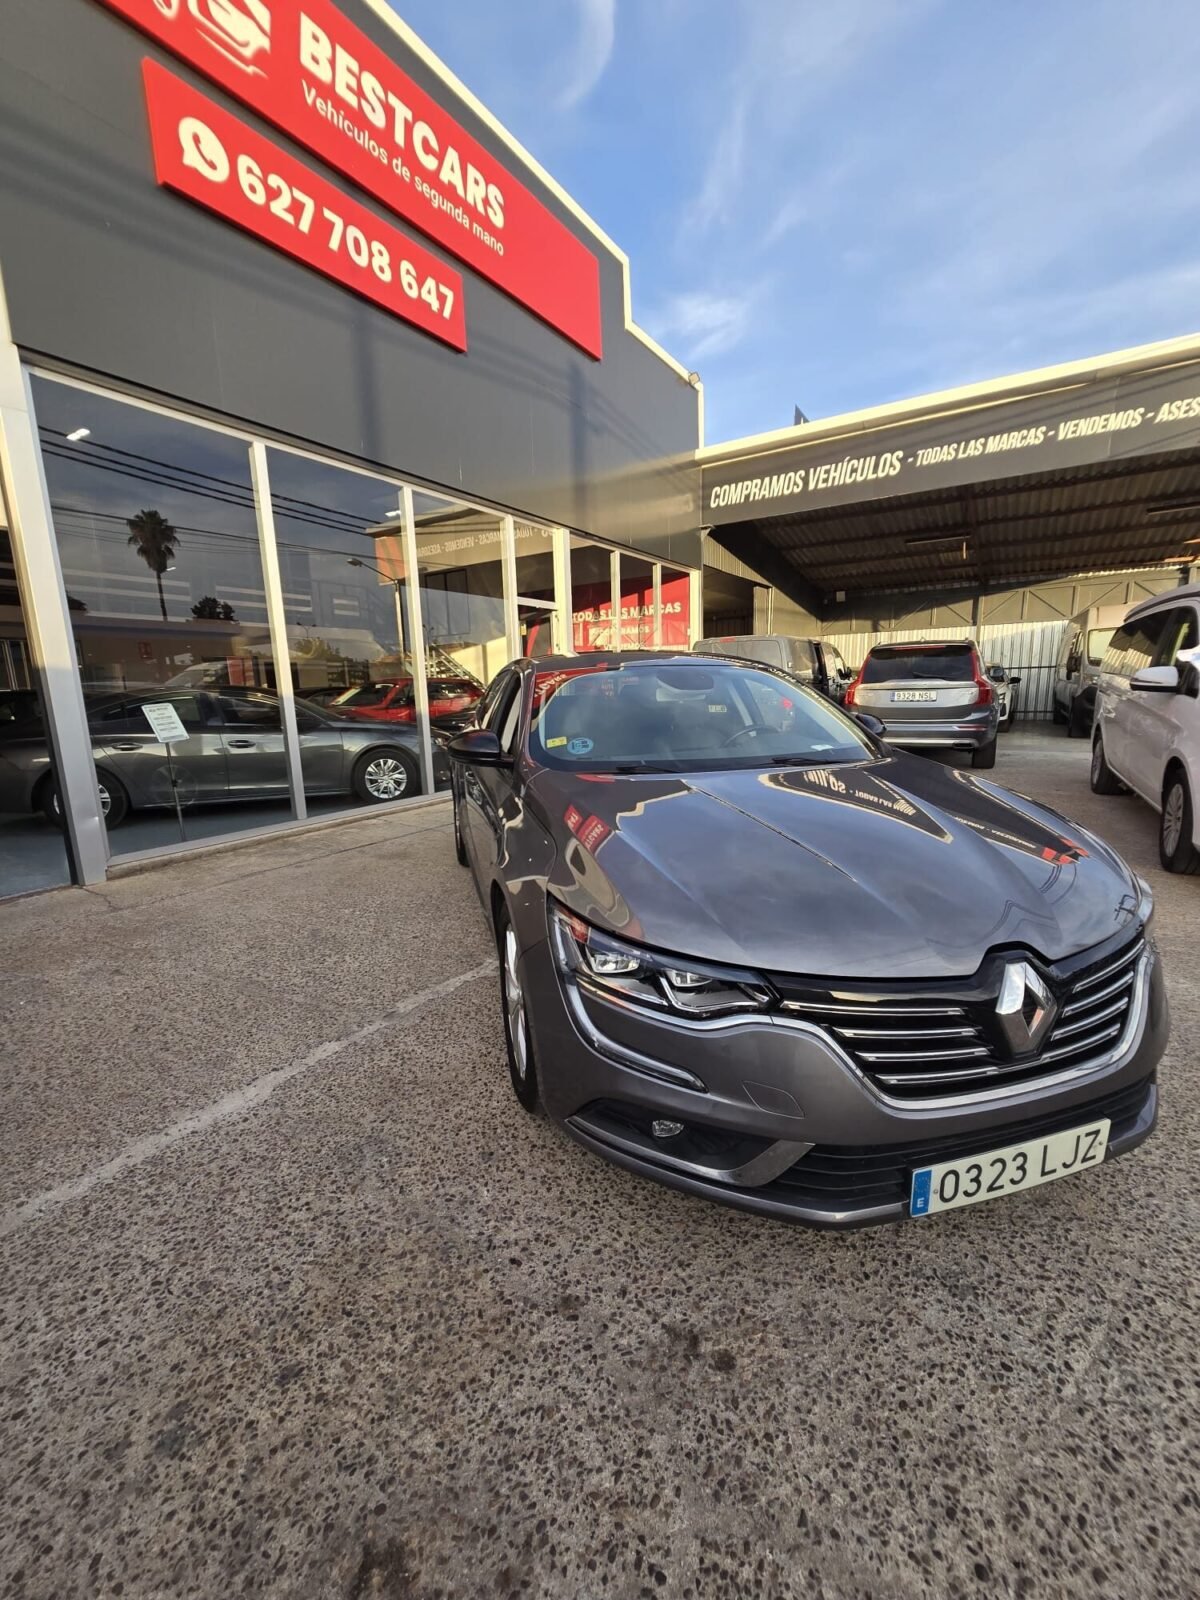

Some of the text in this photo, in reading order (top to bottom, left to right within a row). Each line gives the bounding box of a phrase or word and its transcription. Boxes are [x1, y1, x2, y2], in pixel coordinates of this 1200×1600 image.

[300, 11, 504, 229] BESTCARS
[237, 154, 454, 320] 627 708 647
[392, 157, 411, 183] de
[414, 176, 470, 229] segunda
[473, 221, 504, 257] mano
[710, 470, 805, 508] COMPRAMOS
[808, 450, 904, 491] VEHÍCULOS
[915, 443, 958, 467] TODAS
[957, 437, 986, 459] LAS
[985, 426, 1047, 454] MARCAS
[1057, 407, 1145, 440] VENDEMOS
[608, 607, 628, 620] LS
[896, 692, 933, 700] 9328 NSL
[916, 1197, 925, 1208] E
[939, 1128, 1102, 1203] 0323 LJZ
